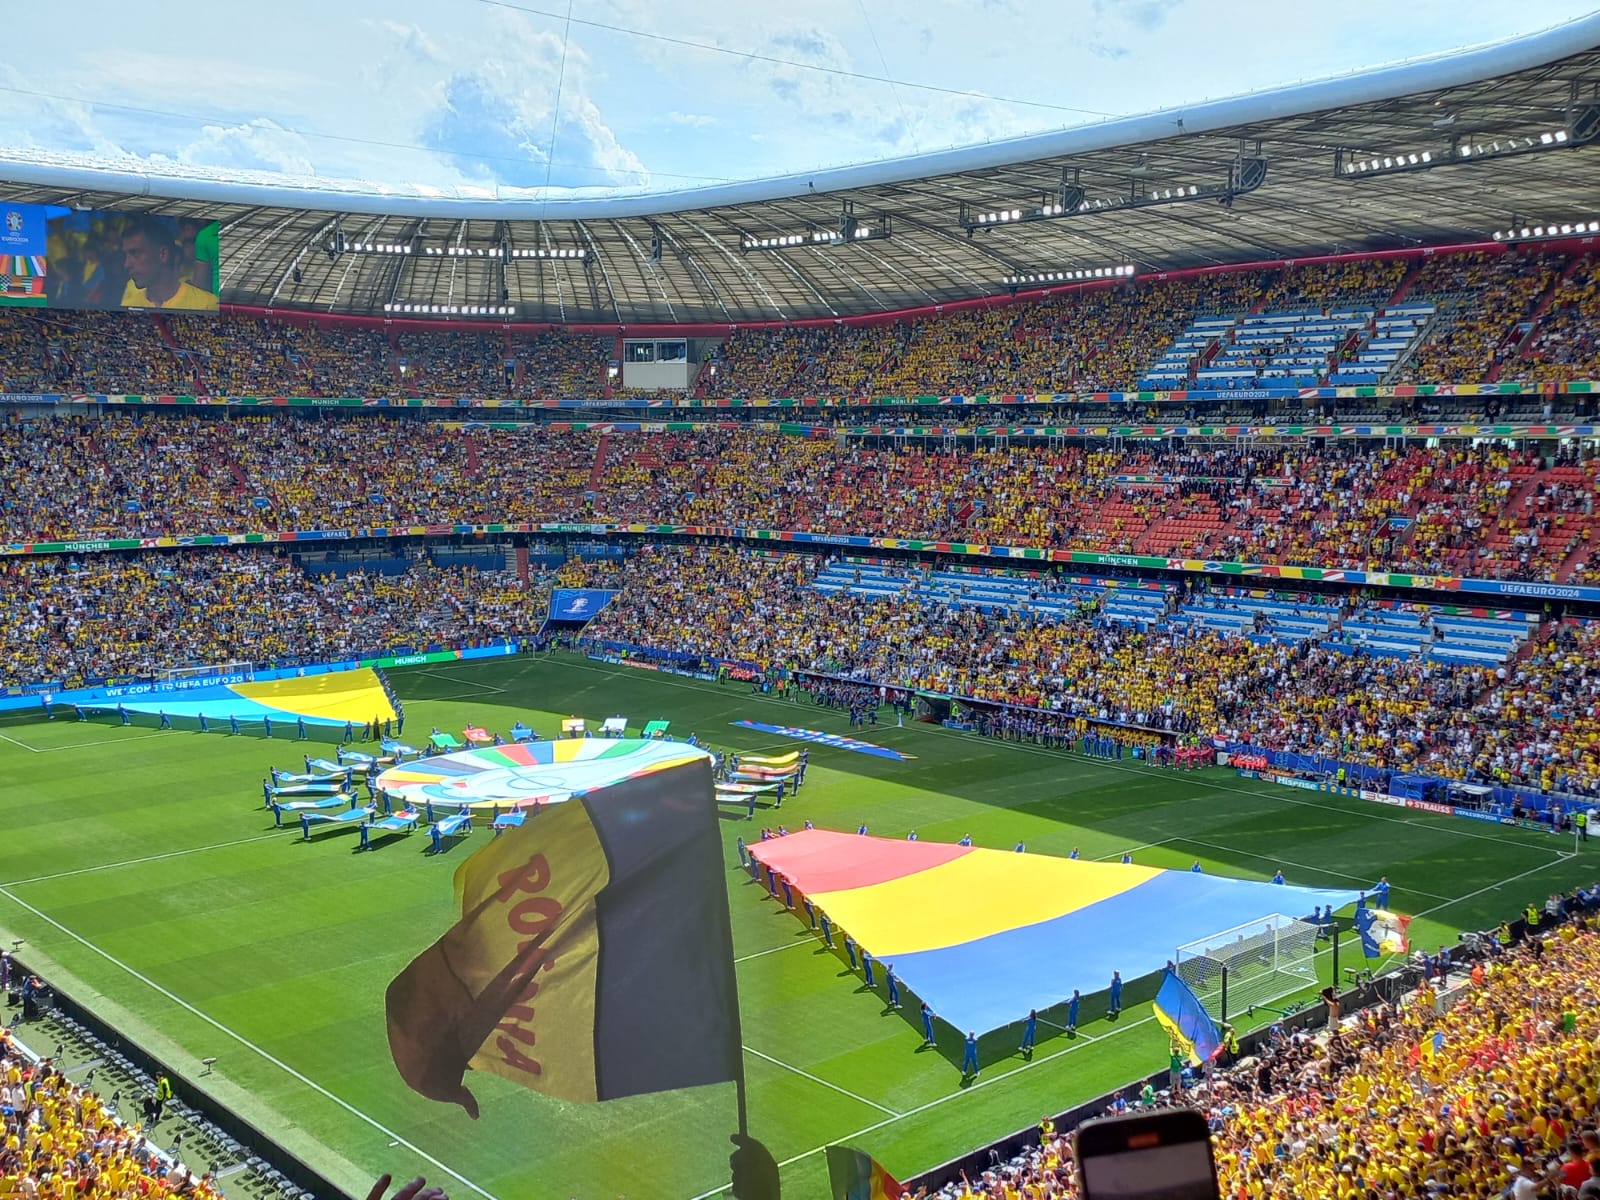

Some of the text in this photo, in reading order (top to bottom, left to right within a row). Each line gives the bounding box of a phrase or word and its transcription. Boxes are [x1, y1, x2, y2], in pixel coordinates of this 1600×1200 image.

[1500, 584, 1580, 598] UEFAEURO2024
[394, 655, 427, 665] MUNICH
[1414, 801, 1451, 814] STRAUSS
